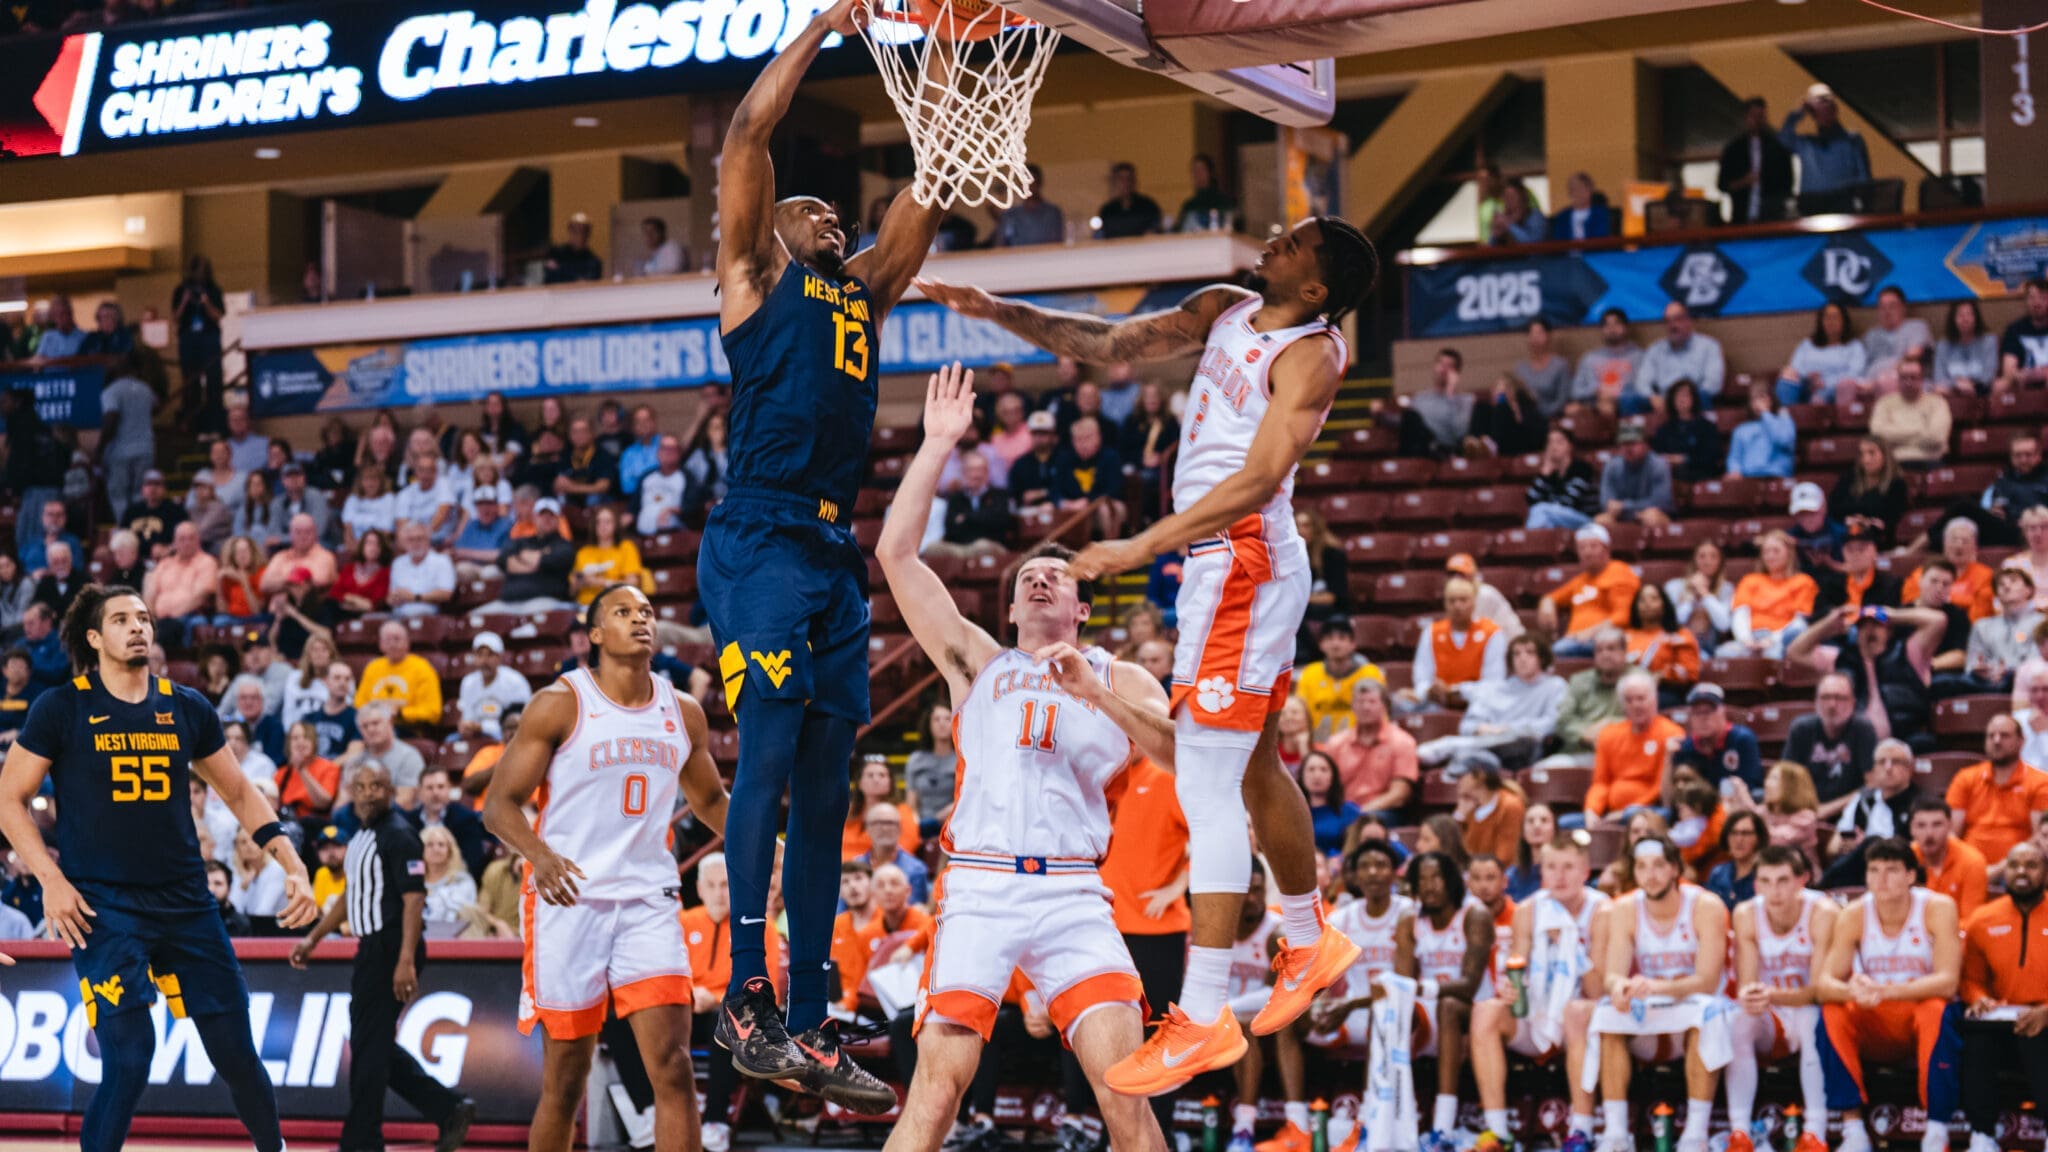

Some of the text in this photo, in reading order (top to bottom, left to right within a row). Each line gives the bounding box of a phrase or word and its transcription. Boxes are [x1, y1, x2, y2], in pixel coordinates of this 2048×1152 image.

[110, 20, 332, 88] SHRINERS
[100, 66, 363, 138] CHILDREN'S
[804, 274, 841, 306] WEST
[1457, 271, 1542, 320] 2025
[404, 340, 540, 397] SHRINERS
[543, 328, 710, 388] CHILDREN'S
[832, 310, 870, 383] 13
[817, 498, 840, 523] WVU
[992, 668, 1098, 716] CLEM
[94, 733, 181, 752] WEST VIRGINIA
[1016, 698, 1061, 754] 11
[110, 755, 172, 802] 55
[588, 736, 680, 774] CLEMSON
[620, 772, 650, 818] 0
